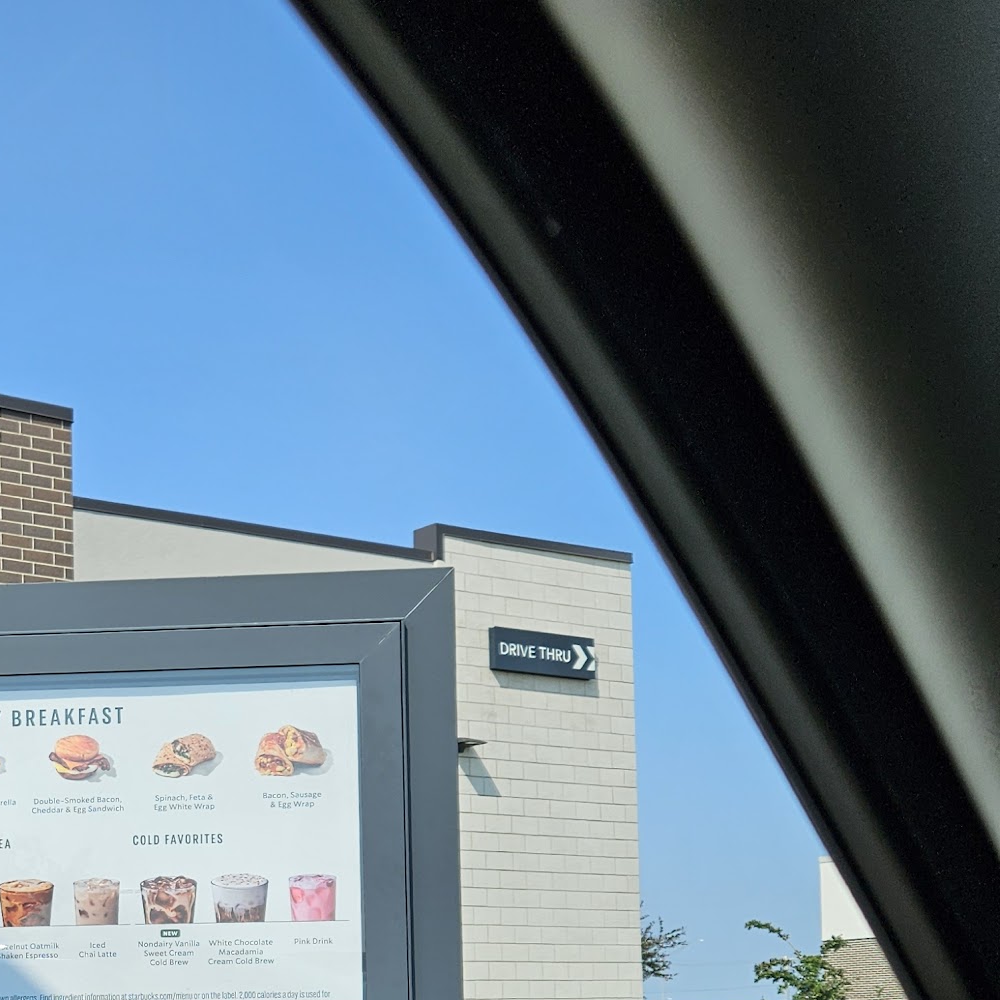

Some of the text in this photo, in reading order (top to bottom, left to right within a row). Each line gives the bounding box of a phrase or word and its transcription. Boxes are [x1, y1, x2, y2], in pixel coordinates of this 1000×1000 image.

[499, 641, 571, 663] DRIVE THRU
[12, 707, 124, 727] BREAKFAST
[155, 794, 187, 802] Spinach,
[207, 793, 213, 801] &
[262, 791, 322, 800] Bacon, Sausage
[33, 796, 123, 805] Double-Smoked Bacon,
[154, 804, 167, 812] Egg
[194, 803, 215, 811] Wrap
[278, 801, 292, 809] Egg
[293, 801, 315, 809] Wrap
[31, 806, 63, 814] Cheddar
[73, 806, 86, 815] Egg
[88, 805, 124, 813] Sandwich
[132, 833, 223, 846] COLD FAVORITES
[138, 941, 173, 949] Nondairy
[234, 938, 273, 946] Chocolate
[312, 937, 333, 945] Drink
[30, 942, 59, 950] Oatmilk
[26, 952, 59, 960] Espresso
[144, 949, 194, 957] Sweet Cream
[218, 948, 264, 956] Macadamia
[235, 957, 253, 965] Cold
[255, 957, 275, 965] Brew
[85, 993, 121, 1000] information
[128, 992, 193, 1000] starbucks.com/menu
[193, 992, 200, 1000] or
[239, 991, 256, 1000] 2,000
[257, 991, 282, 999] calories
[287, 991, 298, 1000] day
[306, 990, 321, 998] used
[322, 990, 331, 998] for
